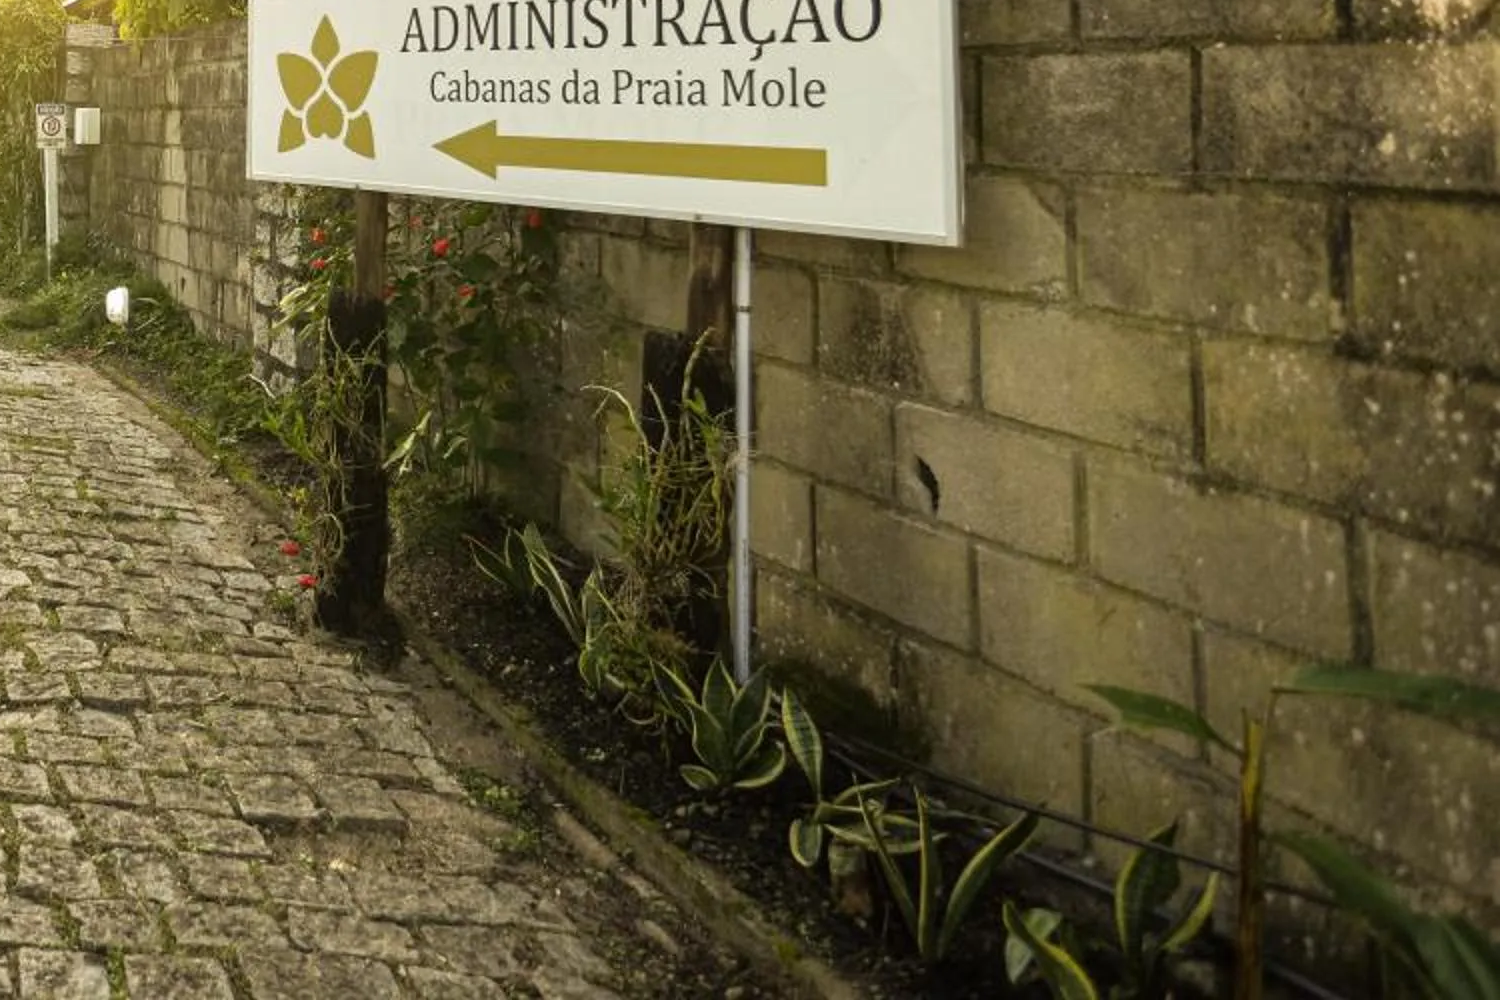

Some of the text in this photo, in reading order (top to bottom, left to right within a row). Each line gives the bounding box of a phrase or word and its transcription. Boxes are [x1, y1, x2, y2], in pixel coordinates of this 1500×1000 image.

[429, 66, 827, 109] Cabanas da Praia Mole
